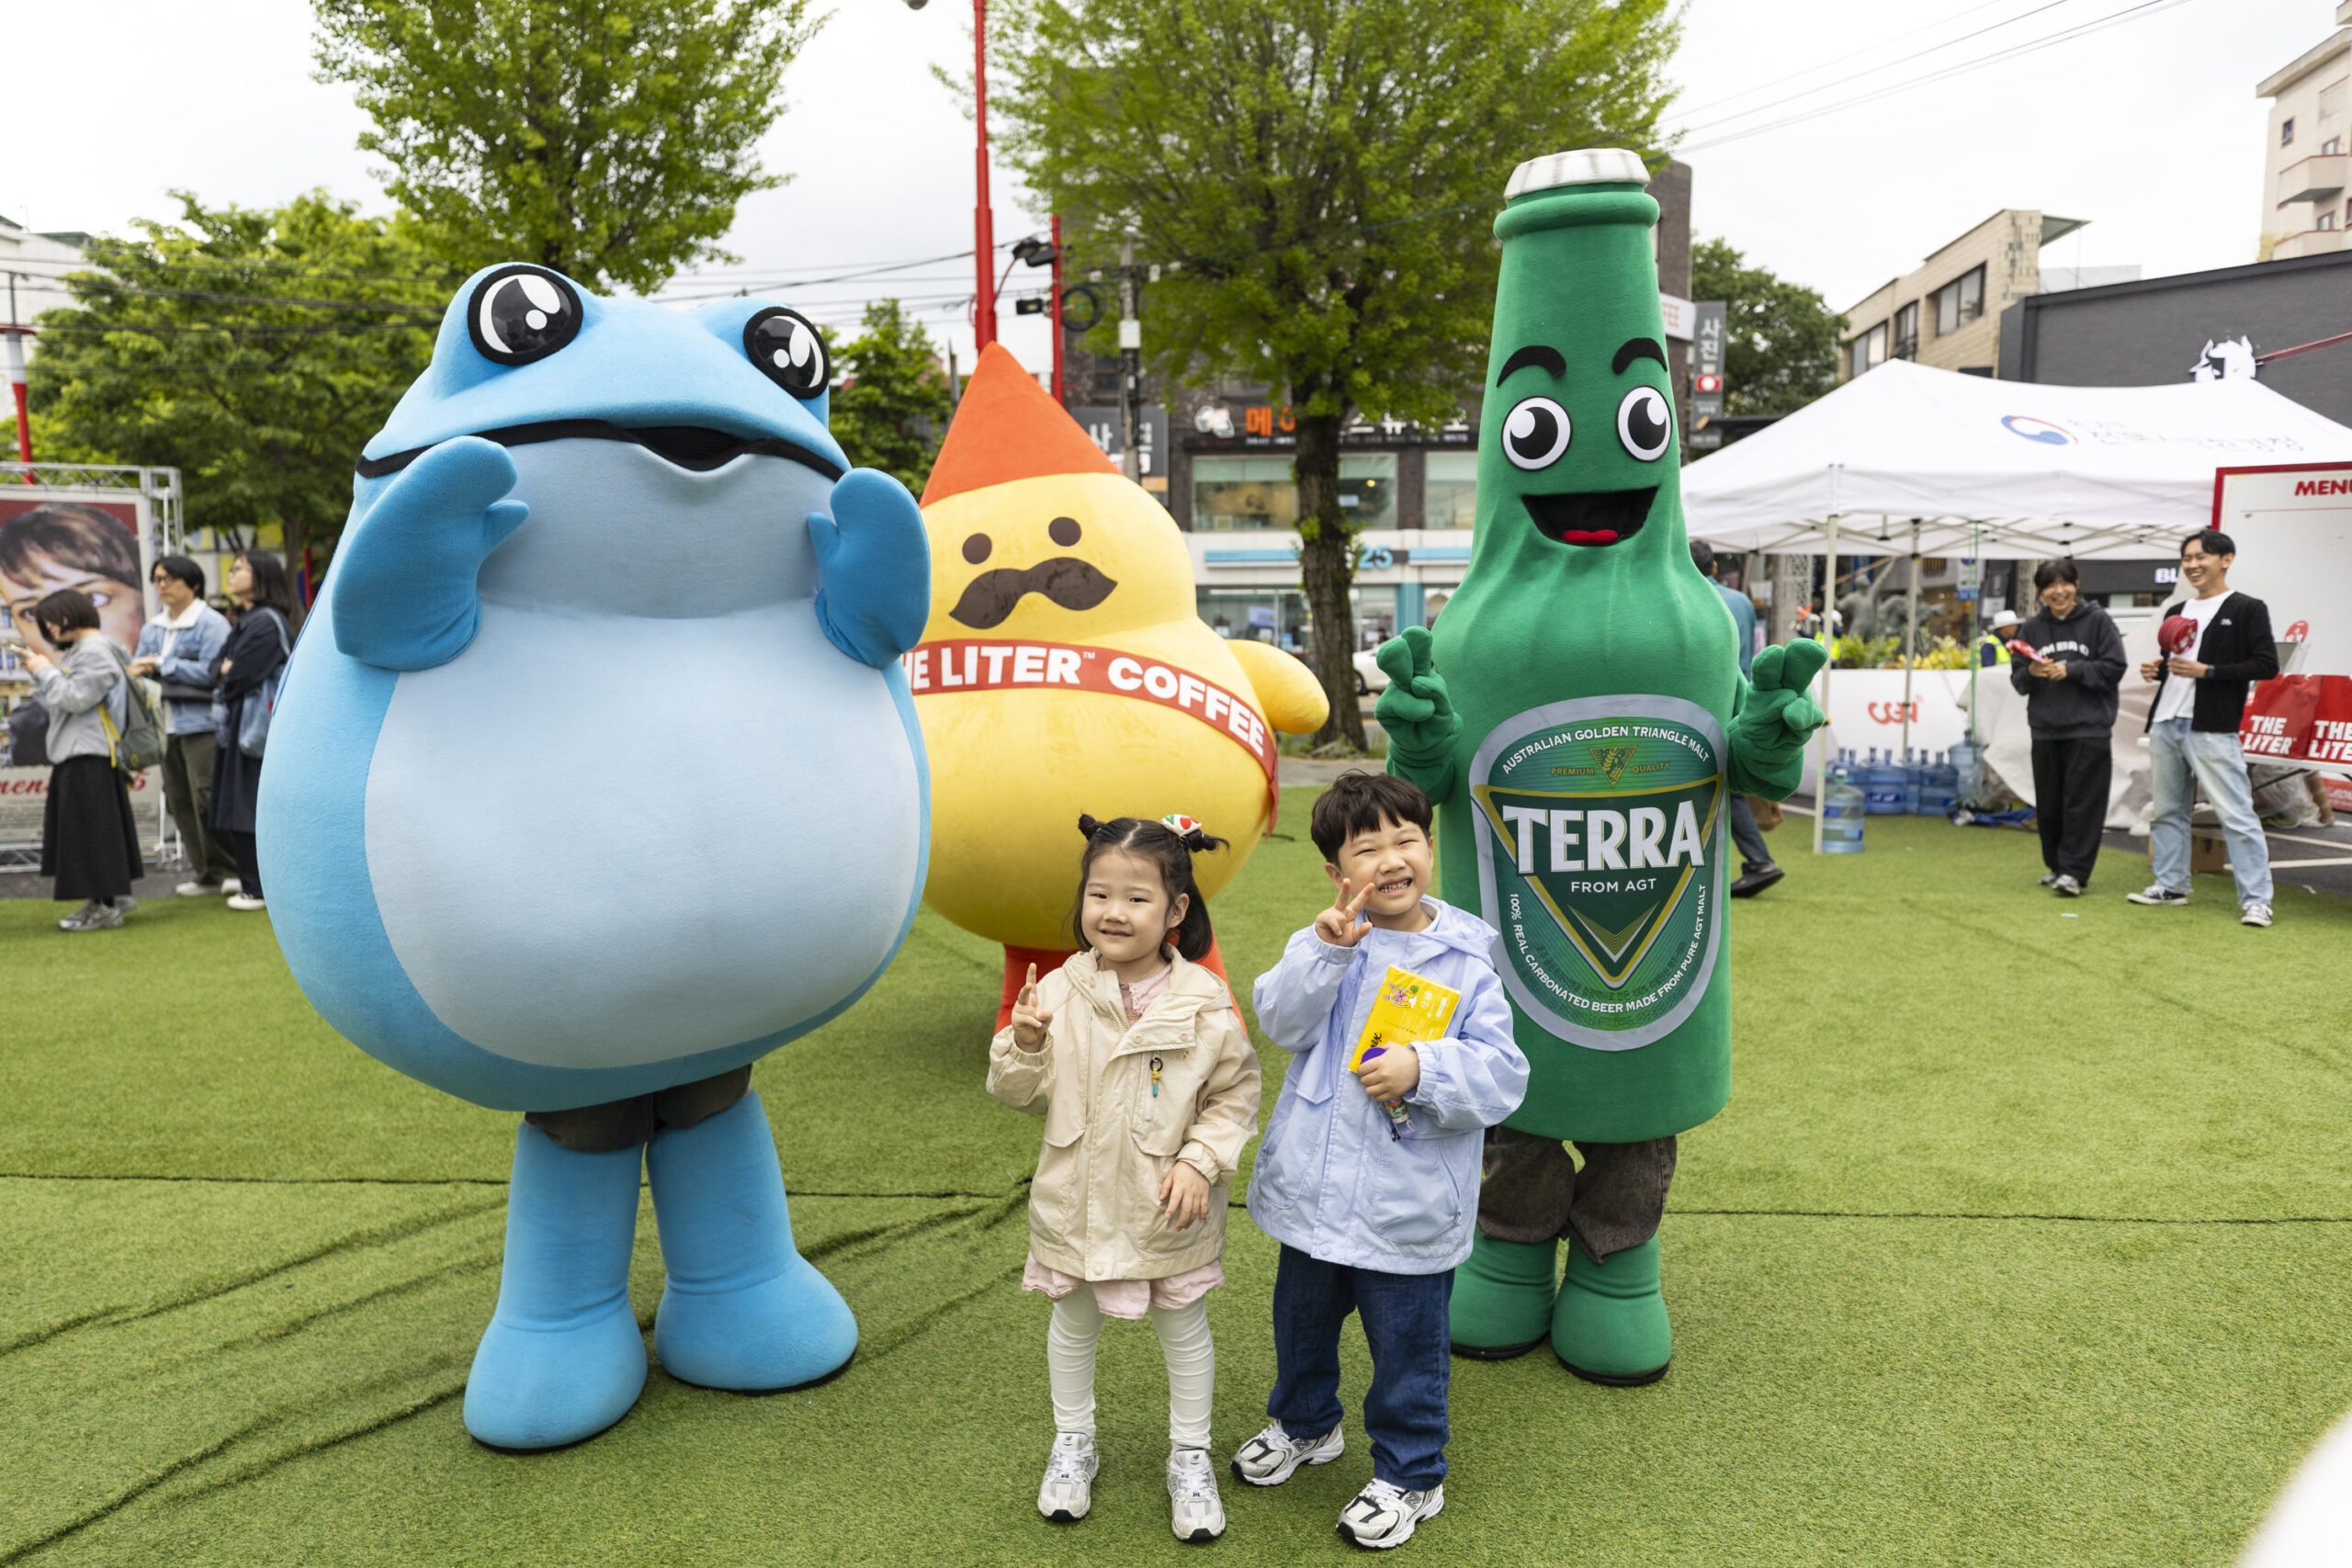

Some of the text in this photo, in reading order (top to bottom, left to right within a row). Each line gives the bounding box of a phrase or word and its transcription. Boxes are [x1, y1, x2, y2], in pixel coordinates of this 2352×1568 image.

[1700, 316, 1723, 361] 사진
[2295, 479, 2352, 496] MEN
[1107, 657, 1265, 757] COFFEE
[2250, 716, 2287, 735] THE
[1502, 726, 1710, 774] AUSTRALIAN GOLDEN TRIANGLE MALT
[1551, 761, 1670, 775] PREMIUM QUALITY
[1502, 799, 1706, 874] TERRA
[1570, 878, 1657, 893] FROM AGT
[1510, 884, 1707, 1013] 100% REAL CARBONATED BEER MADE FROM PURE AGT MALT
